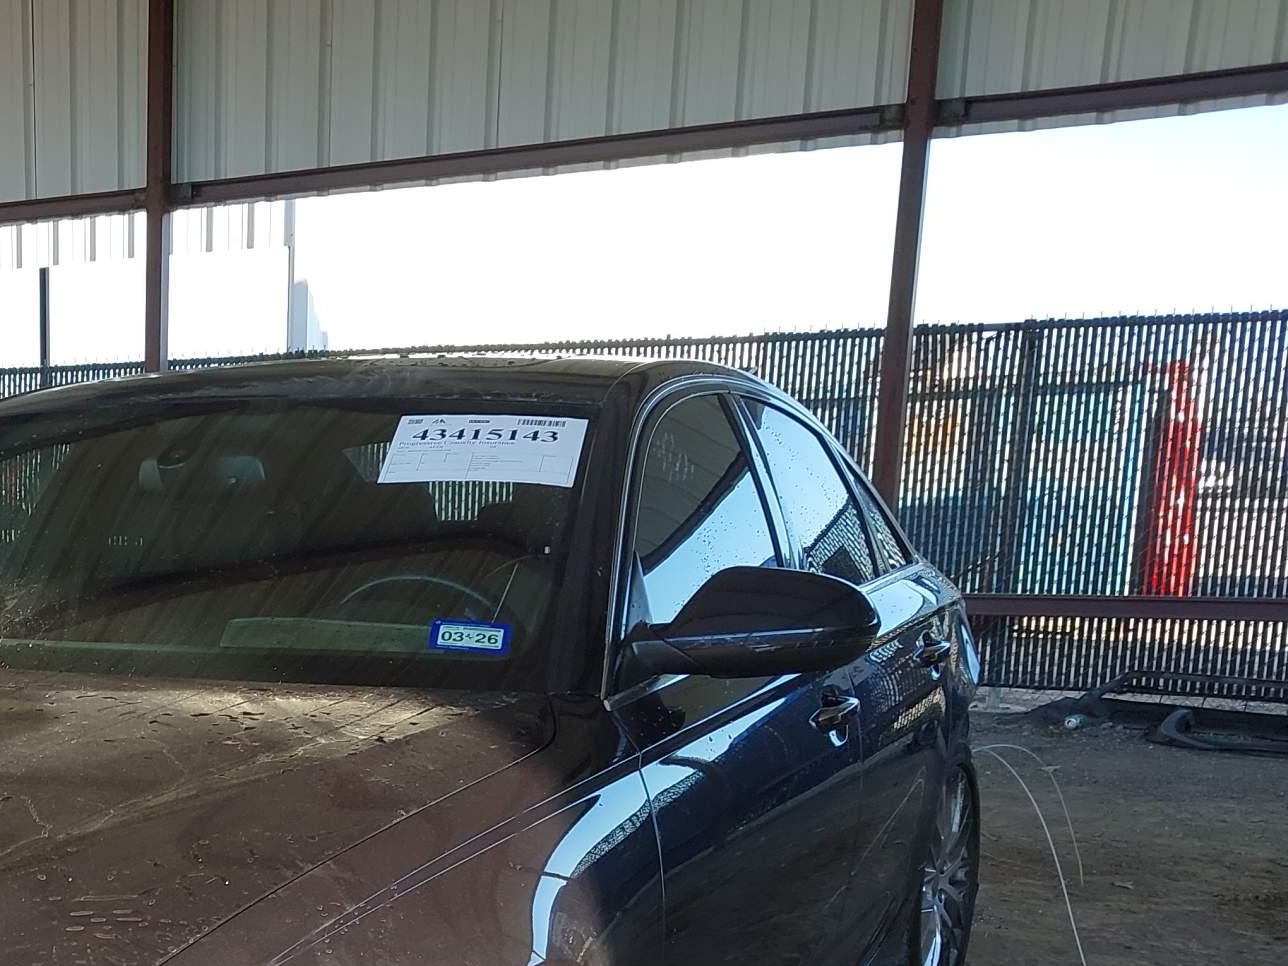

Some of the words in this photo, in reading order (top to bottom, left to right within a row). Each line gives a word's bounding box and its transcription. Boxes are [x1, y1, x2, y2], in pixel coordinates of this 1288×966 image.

[411, 427, 560, 443] 43415143
[441, 630, 465, 642] 03
[475, 633, 499, 645] 26
